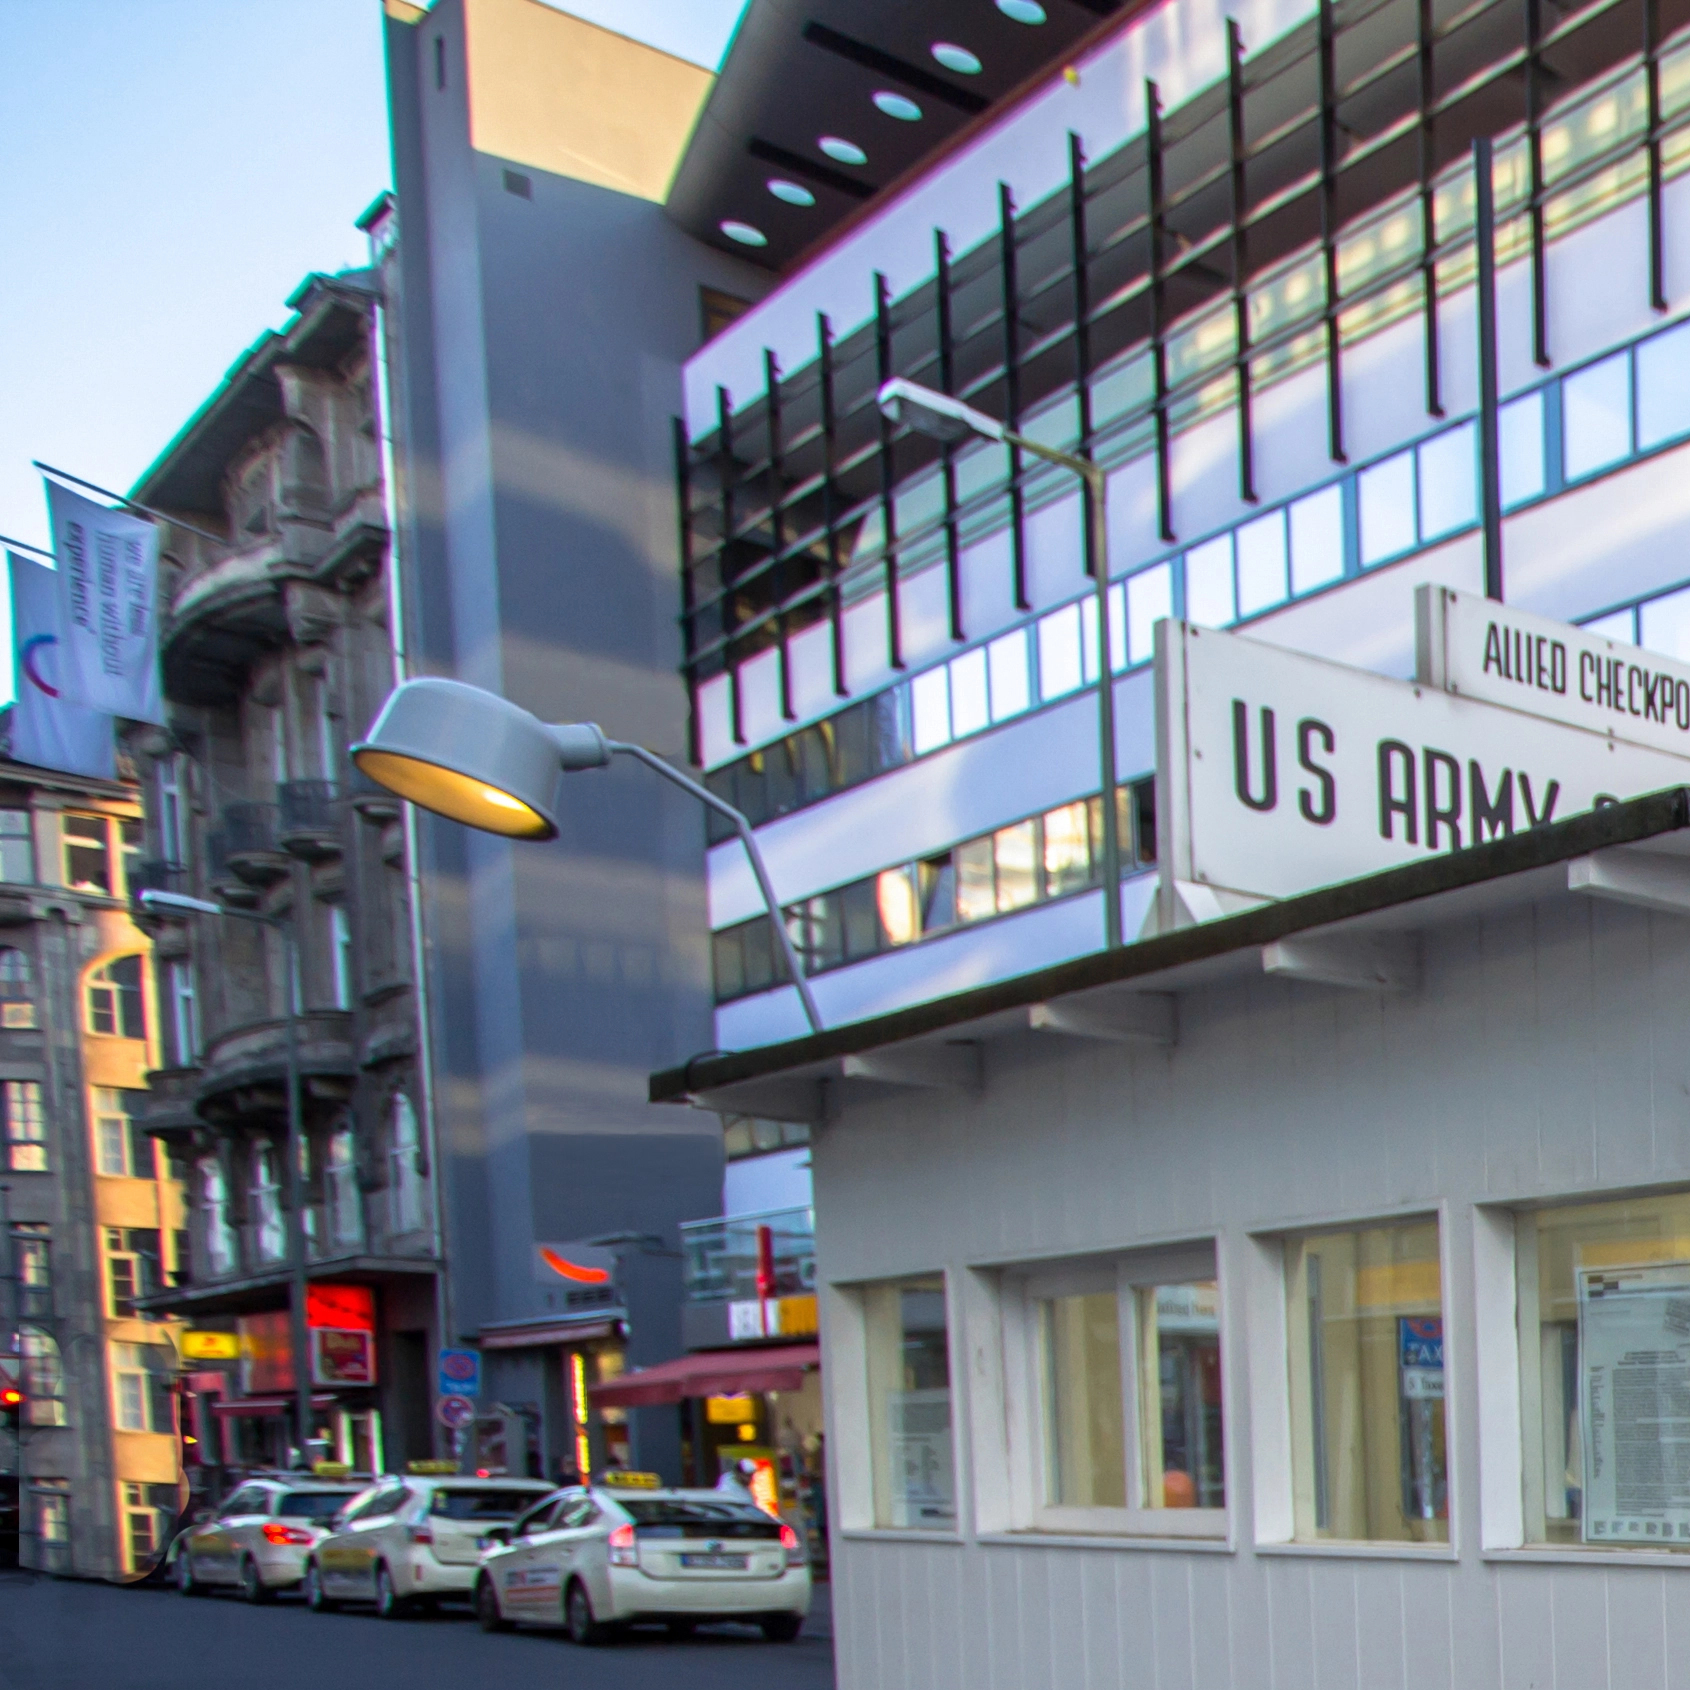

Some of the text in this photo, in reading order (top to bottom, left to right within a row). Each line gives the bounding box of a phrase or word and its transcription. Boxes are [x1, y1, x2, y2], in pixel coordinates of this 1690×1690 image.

[96, 531, 126, 676] human without
[1483, 622, 1567, 694] ALLIED
[1232, 700, 1561, 852] US ARMY
[1408, 1343, 1443, 1362] TAX
